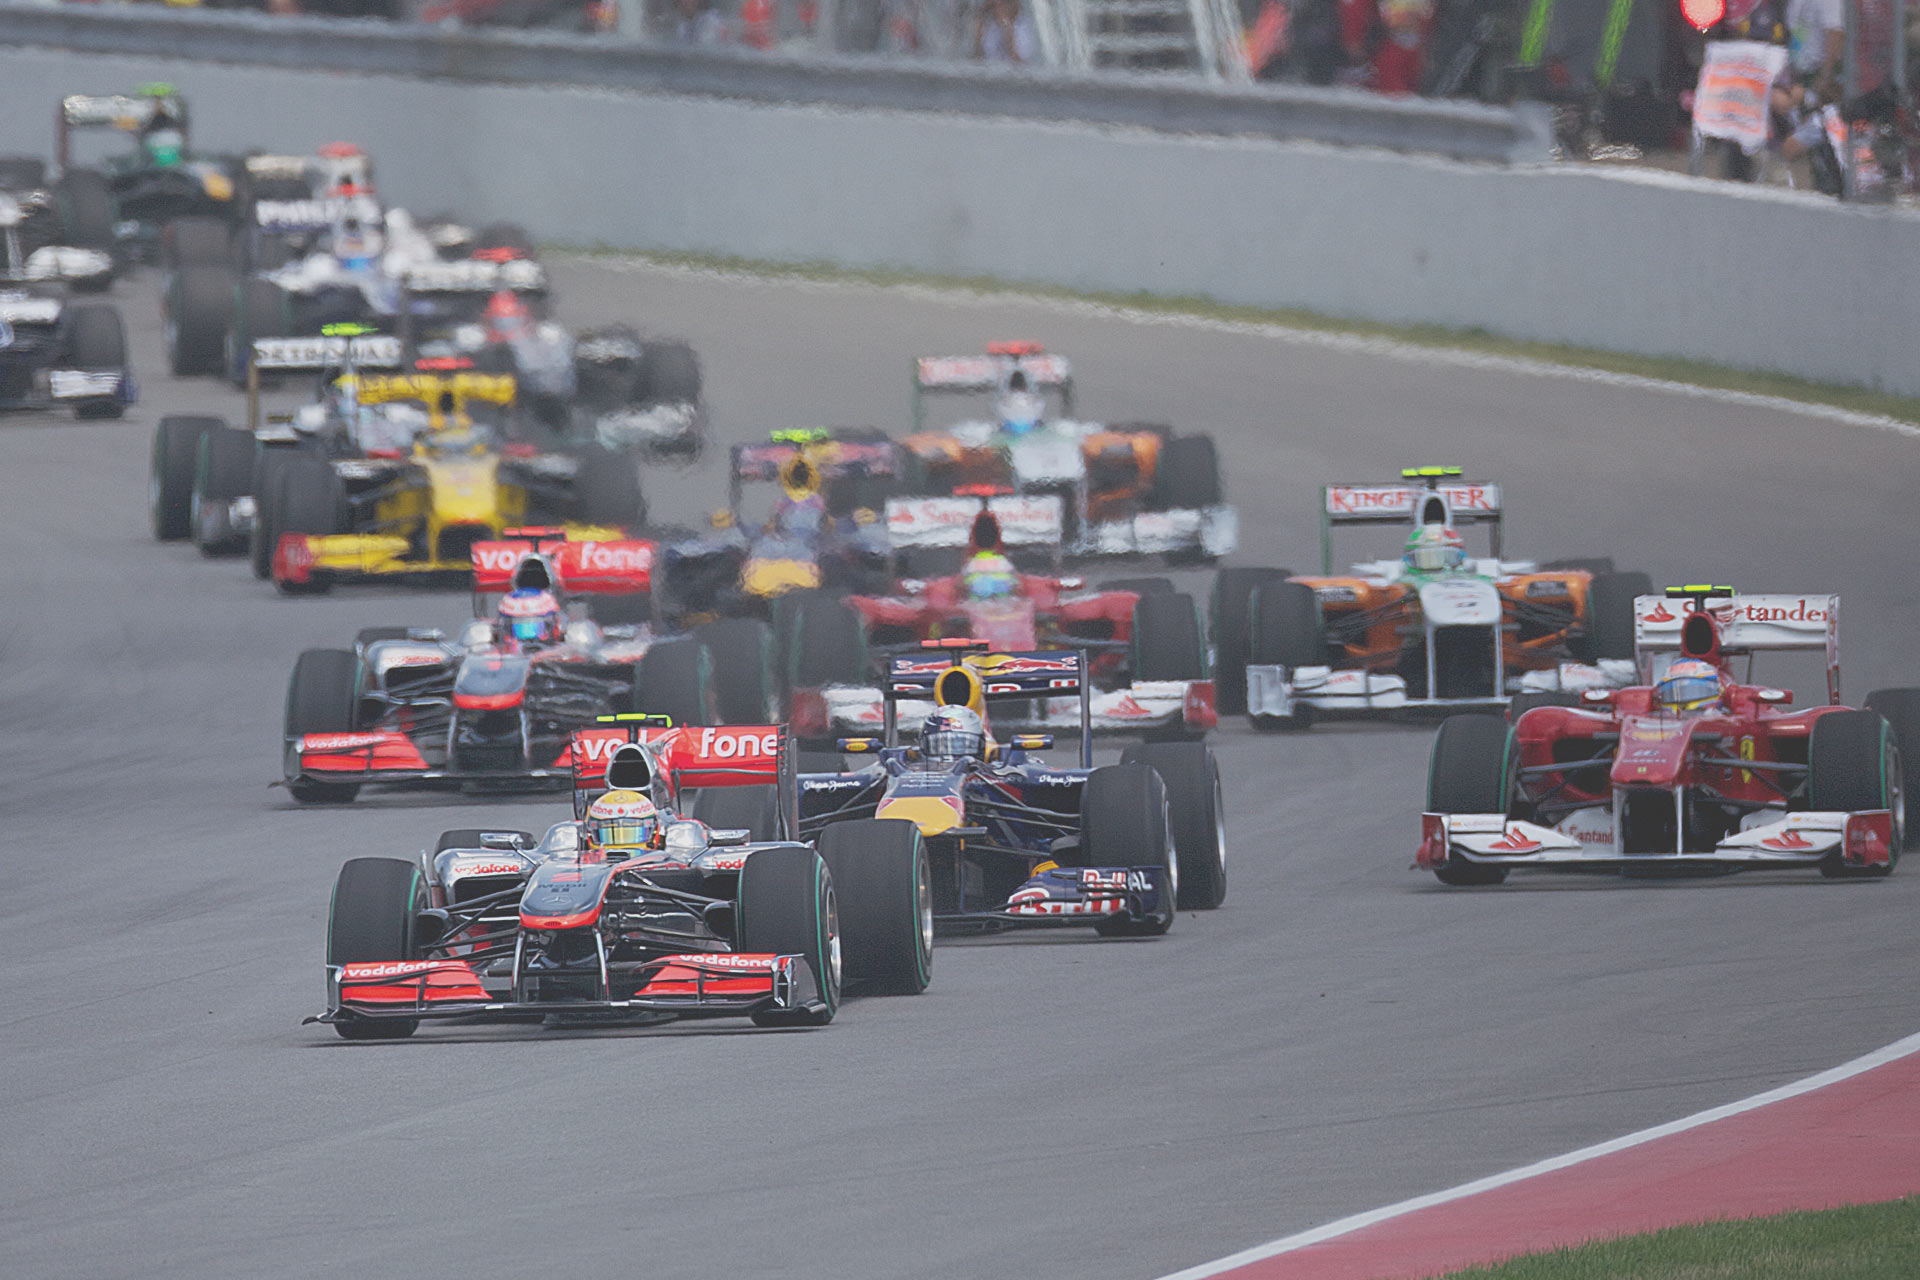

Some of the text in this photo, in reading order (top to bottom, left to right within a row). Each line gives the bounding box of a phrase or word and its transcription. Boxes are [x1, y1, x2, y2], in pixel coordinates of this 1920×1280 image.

[1332, 486, 1492, 512] KINGFER
[479, 541, 651, 571] vofone
[1682, 599, 1828, 622] Stande
[307, 735, 385, 749] vodafone
[583, 728, 778, 761] vofone
[454, 863, 520, 875] vodafone
[715, 858, 745, 870] vod
[348, 961, 440, 978] vodafone
[679, 954, 773, 968] vodafone
